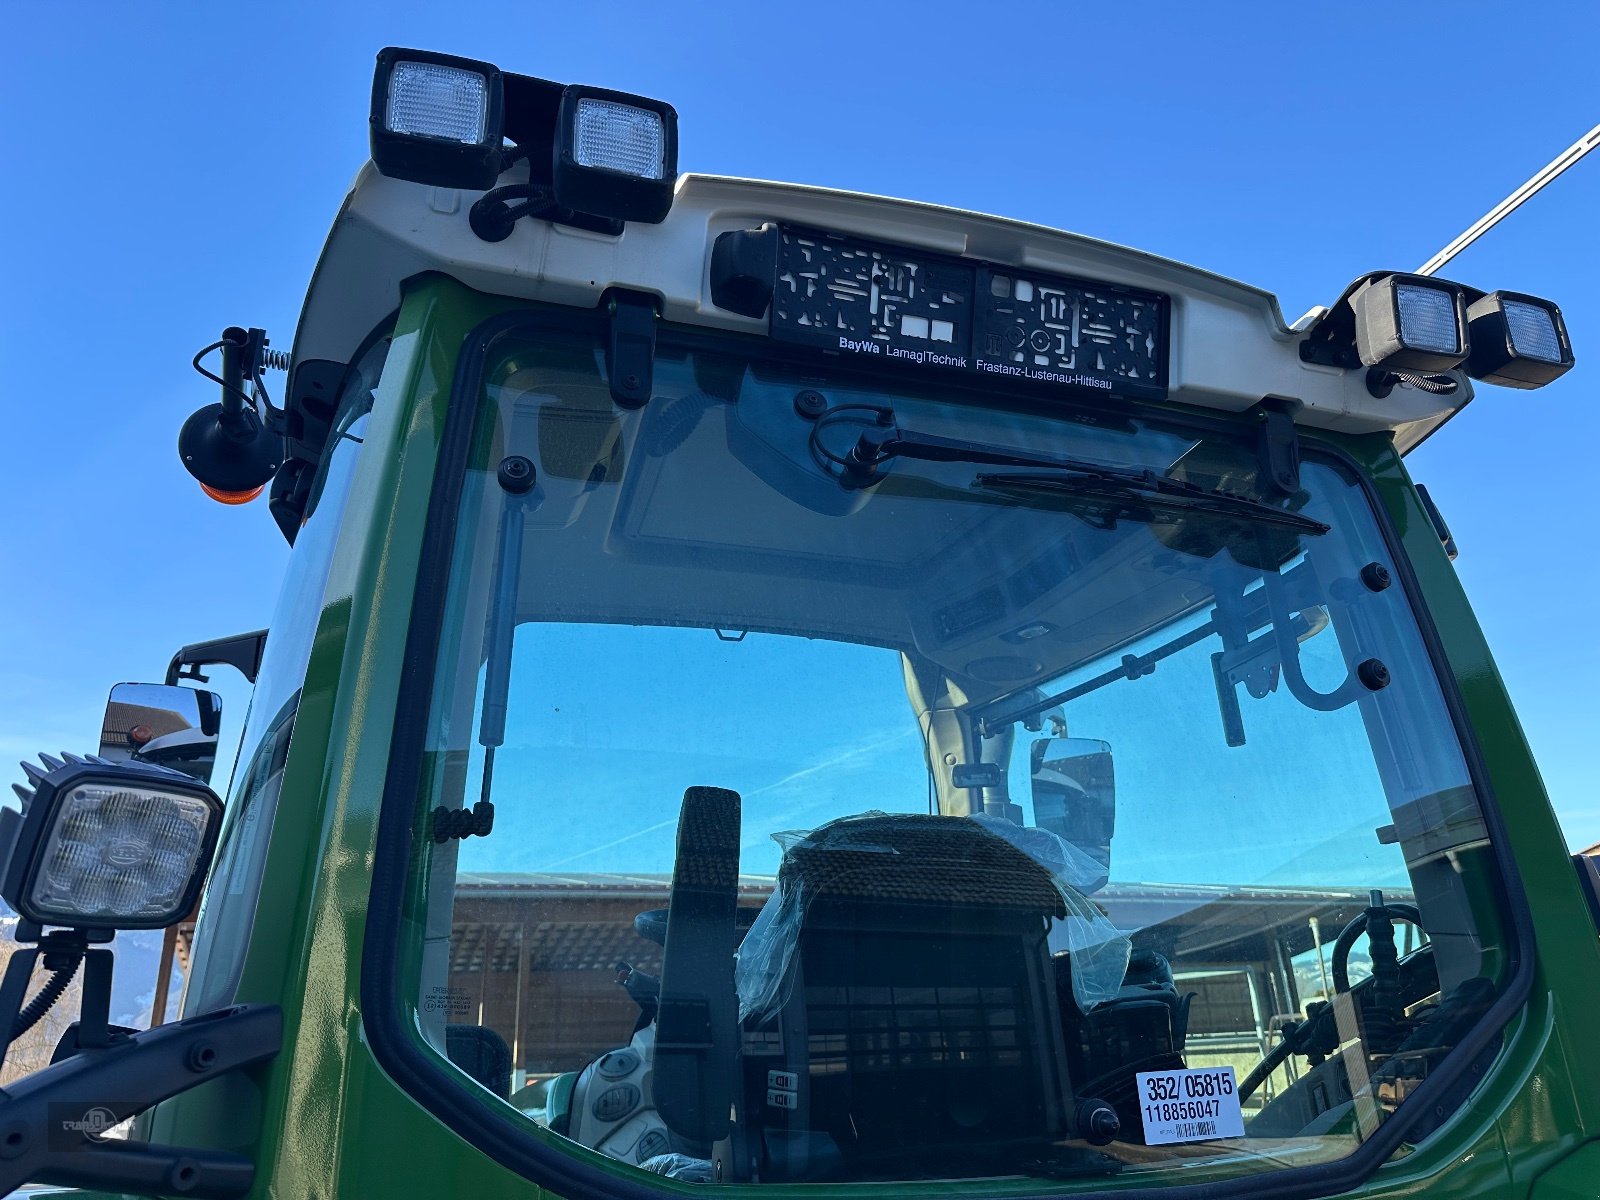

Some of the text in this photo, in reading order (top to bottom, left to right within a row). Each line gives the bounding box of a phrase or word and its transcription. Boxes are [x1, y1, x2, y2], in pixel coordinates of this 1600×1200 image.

[839, 336, 880, 354] BayWa
[976, 359, 1112, 390] Frastanz-Lustenau-Hittisau
[1145, 1099, 1219, 1123] 118856047
